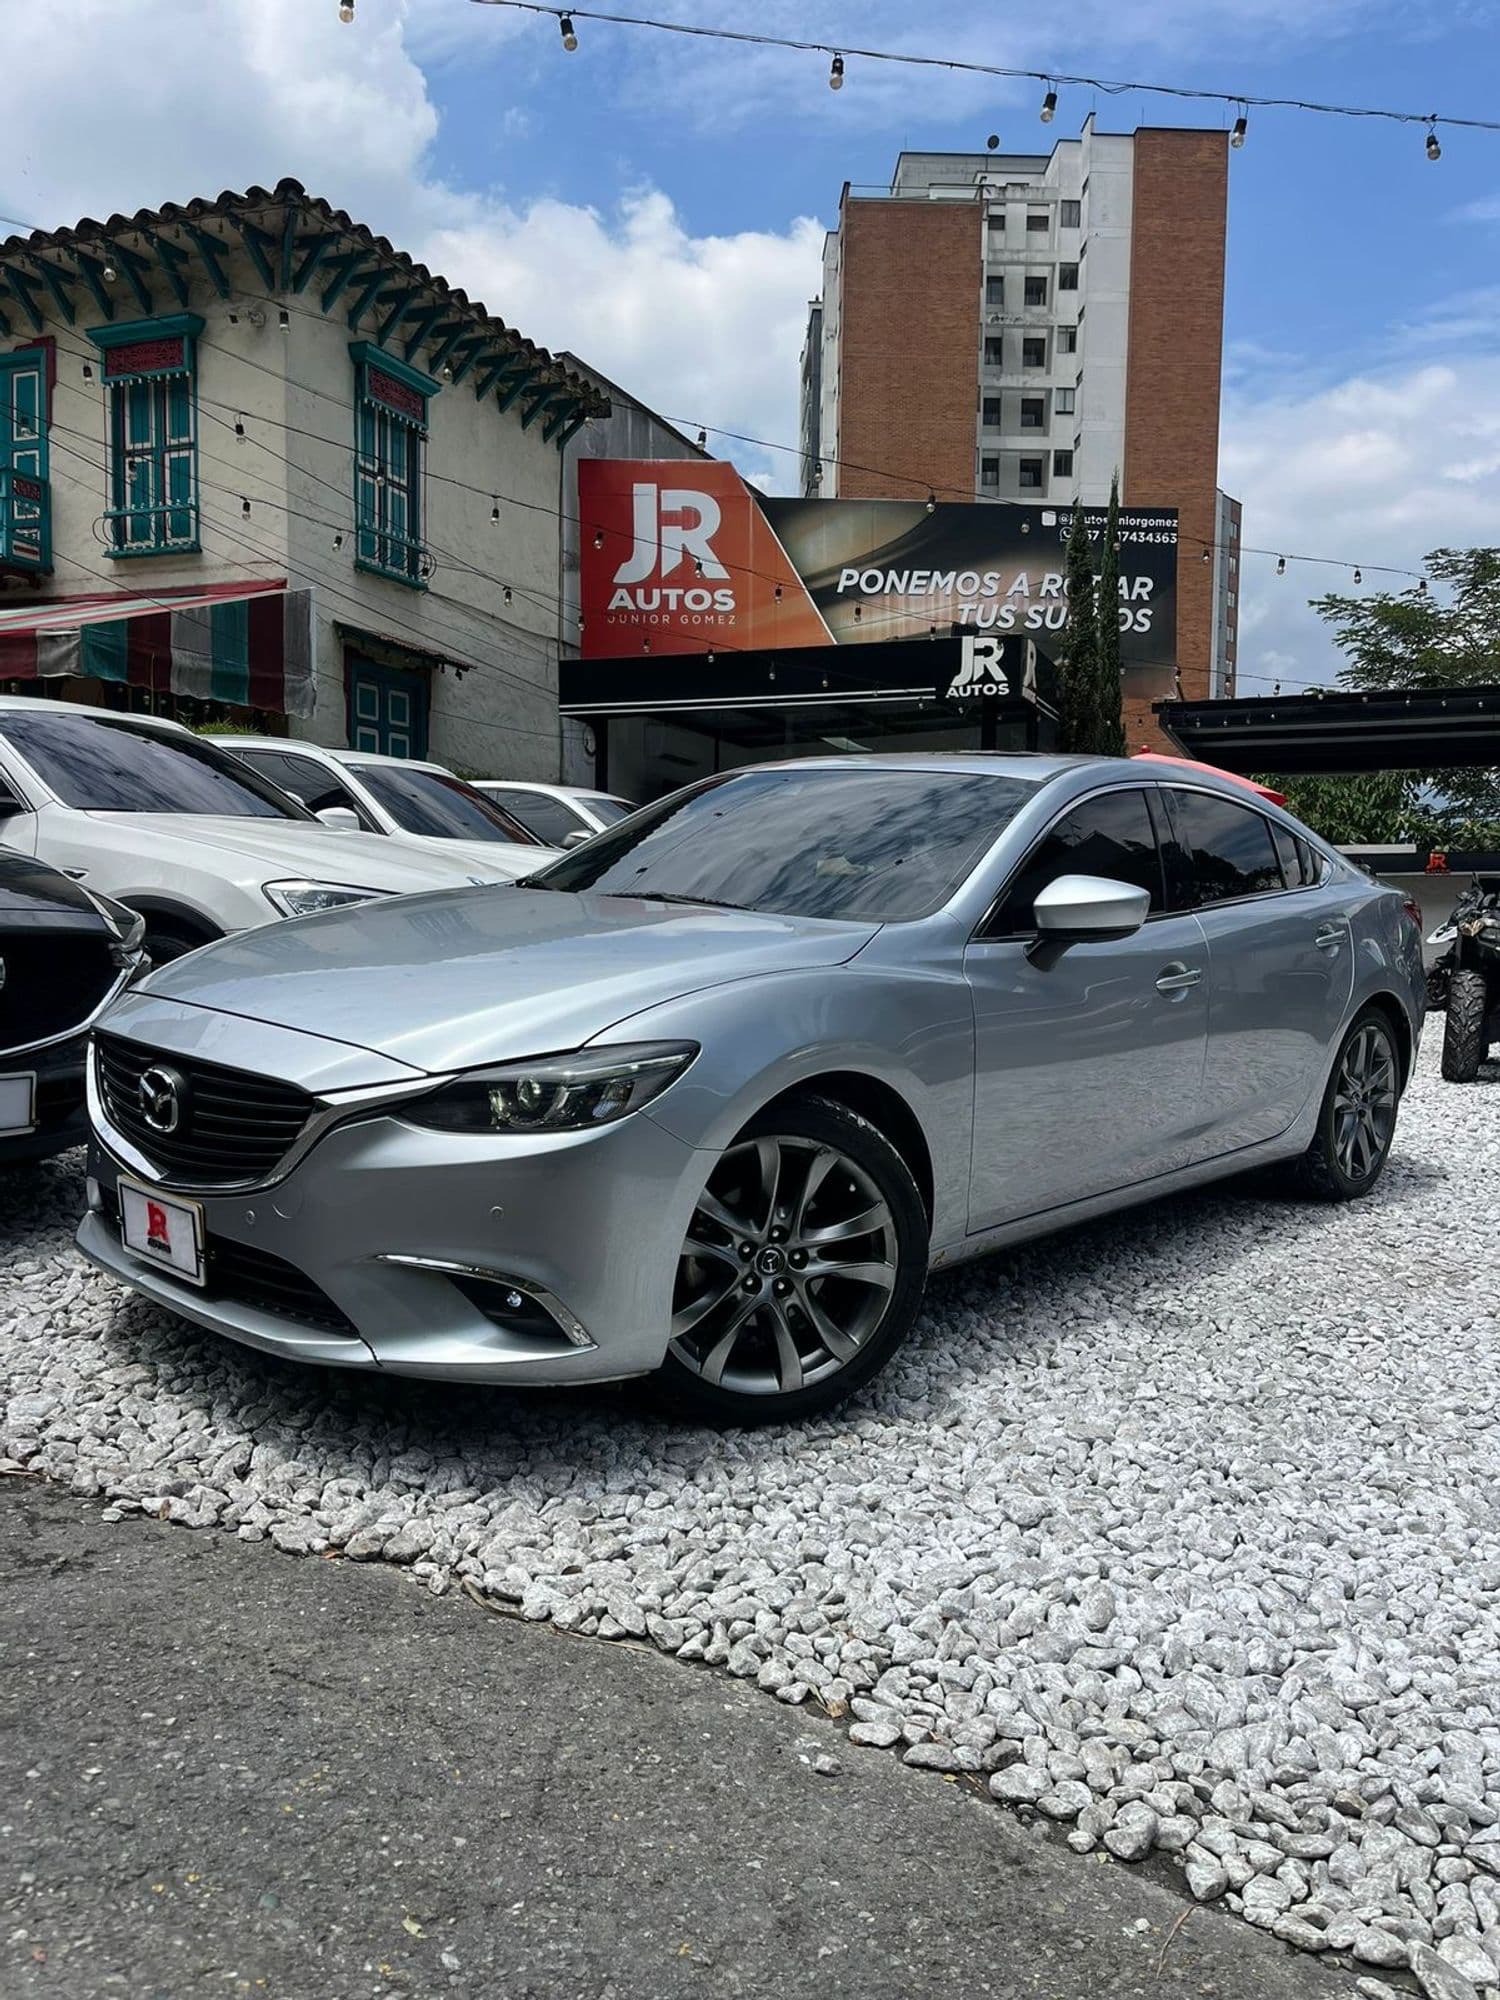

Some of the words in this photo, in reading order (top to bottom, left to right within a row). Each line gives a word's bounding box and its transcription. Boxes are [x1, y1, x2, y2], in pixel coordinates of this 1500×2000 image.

[612, 483, 731, 584] JR
[837, 568, 1001, 597] PONEMOS
[1006, 572, 1030, 597] A
[1039, 572, 1154, 600] RAR
[607, 588, 736, 611] AUTOS
[607, 614, 671, 625] JUNIOR
[680, 614, 737, 625] GOMEZ
[958, 603, 1017, 629] TUS
[1023, 603, 1154, 633] SUOS
[950, 635, 1008, 687] JR
[945, 683, 1010, 698] AUTOS
